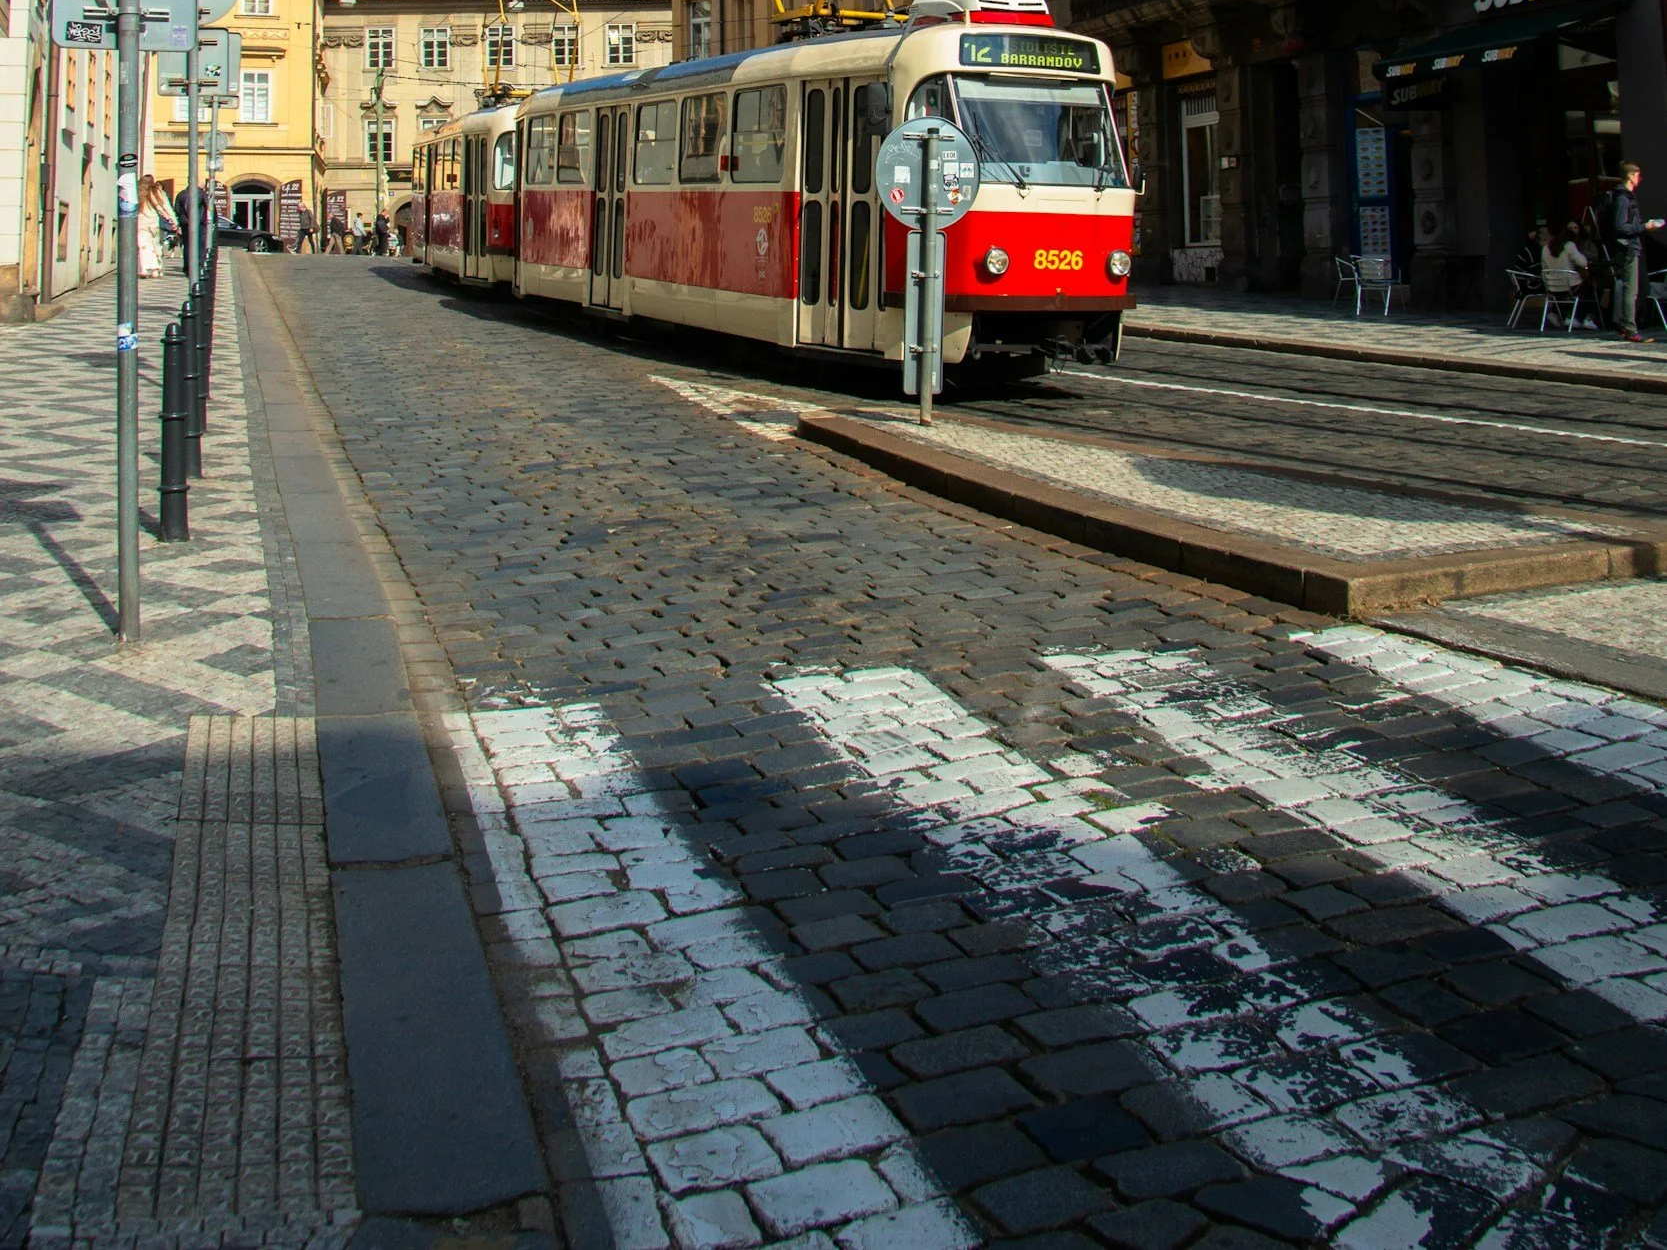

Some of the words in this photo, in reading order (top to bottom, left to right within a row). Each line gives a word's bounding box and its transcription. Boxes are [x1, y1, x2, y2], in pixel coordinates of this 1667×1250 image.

[1001, 53, 1082, 68] BARRANDOV
[1481, 46, 1518, 62] SUBWAY
[1385, 62, 1417, 79] SUBWAY
[1431, 55, 1465, 71] SUBWAY
[1390, 75, 1447, 106] SUBWAY
[754, 206, 771, 223] 8526
[1034, 249, 1083, 270] 8526
